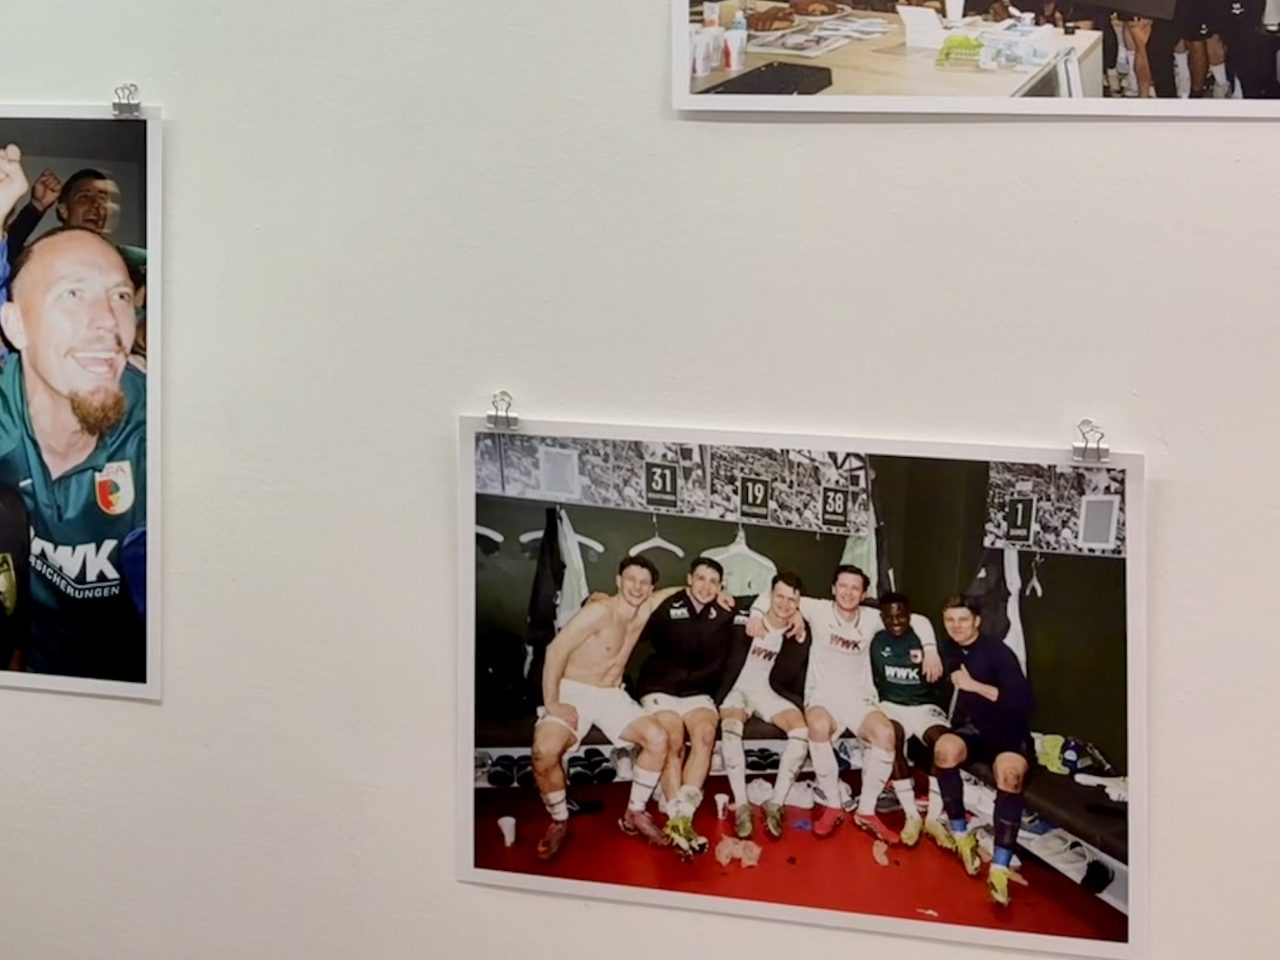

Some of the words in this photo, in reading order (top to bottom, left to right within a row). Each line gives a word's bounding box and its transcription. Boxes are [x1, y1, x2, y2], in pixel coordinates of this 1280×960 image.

[651, 467, 671, 493] 31
[746, 482, 765, 505] 19
[825, 491, 845, 514] 38
[1016, 502, 1023, 526] 1
[29, 554, 121, 600] RSICHERUNGEN
[829, 634, 862, 652] WWK
[884, 664, 921, 681] WWK
